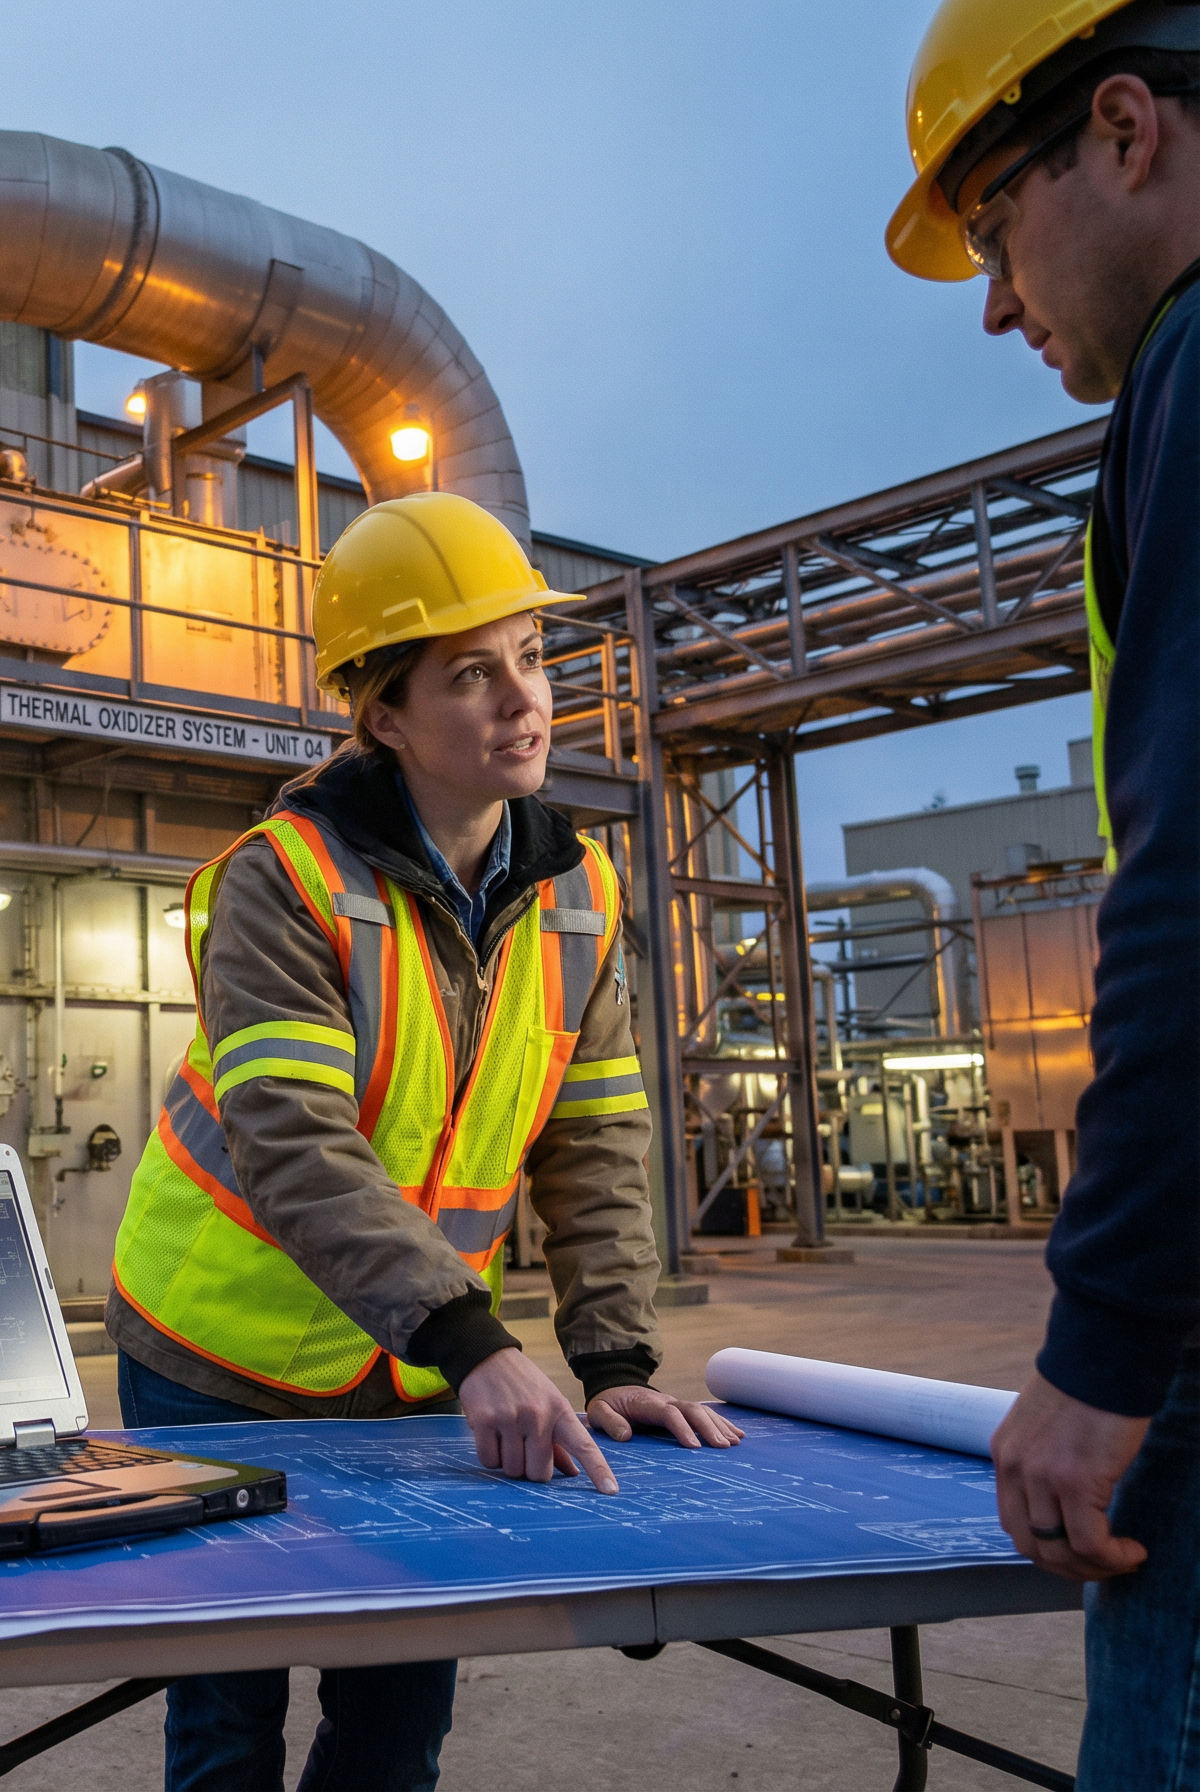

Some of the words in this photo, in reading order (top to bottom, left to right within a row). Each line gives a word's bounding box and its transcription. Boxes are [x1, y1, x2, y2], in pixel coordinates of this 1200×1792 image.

[7, 693, 91, 727] THERMAL
[99, 707, 176, 739] OXIDIZER
[182, 721, 246, 749] SYSTEM
[265, 733, 299, 757] UNIT
[305, 740, 324, 759] 04
